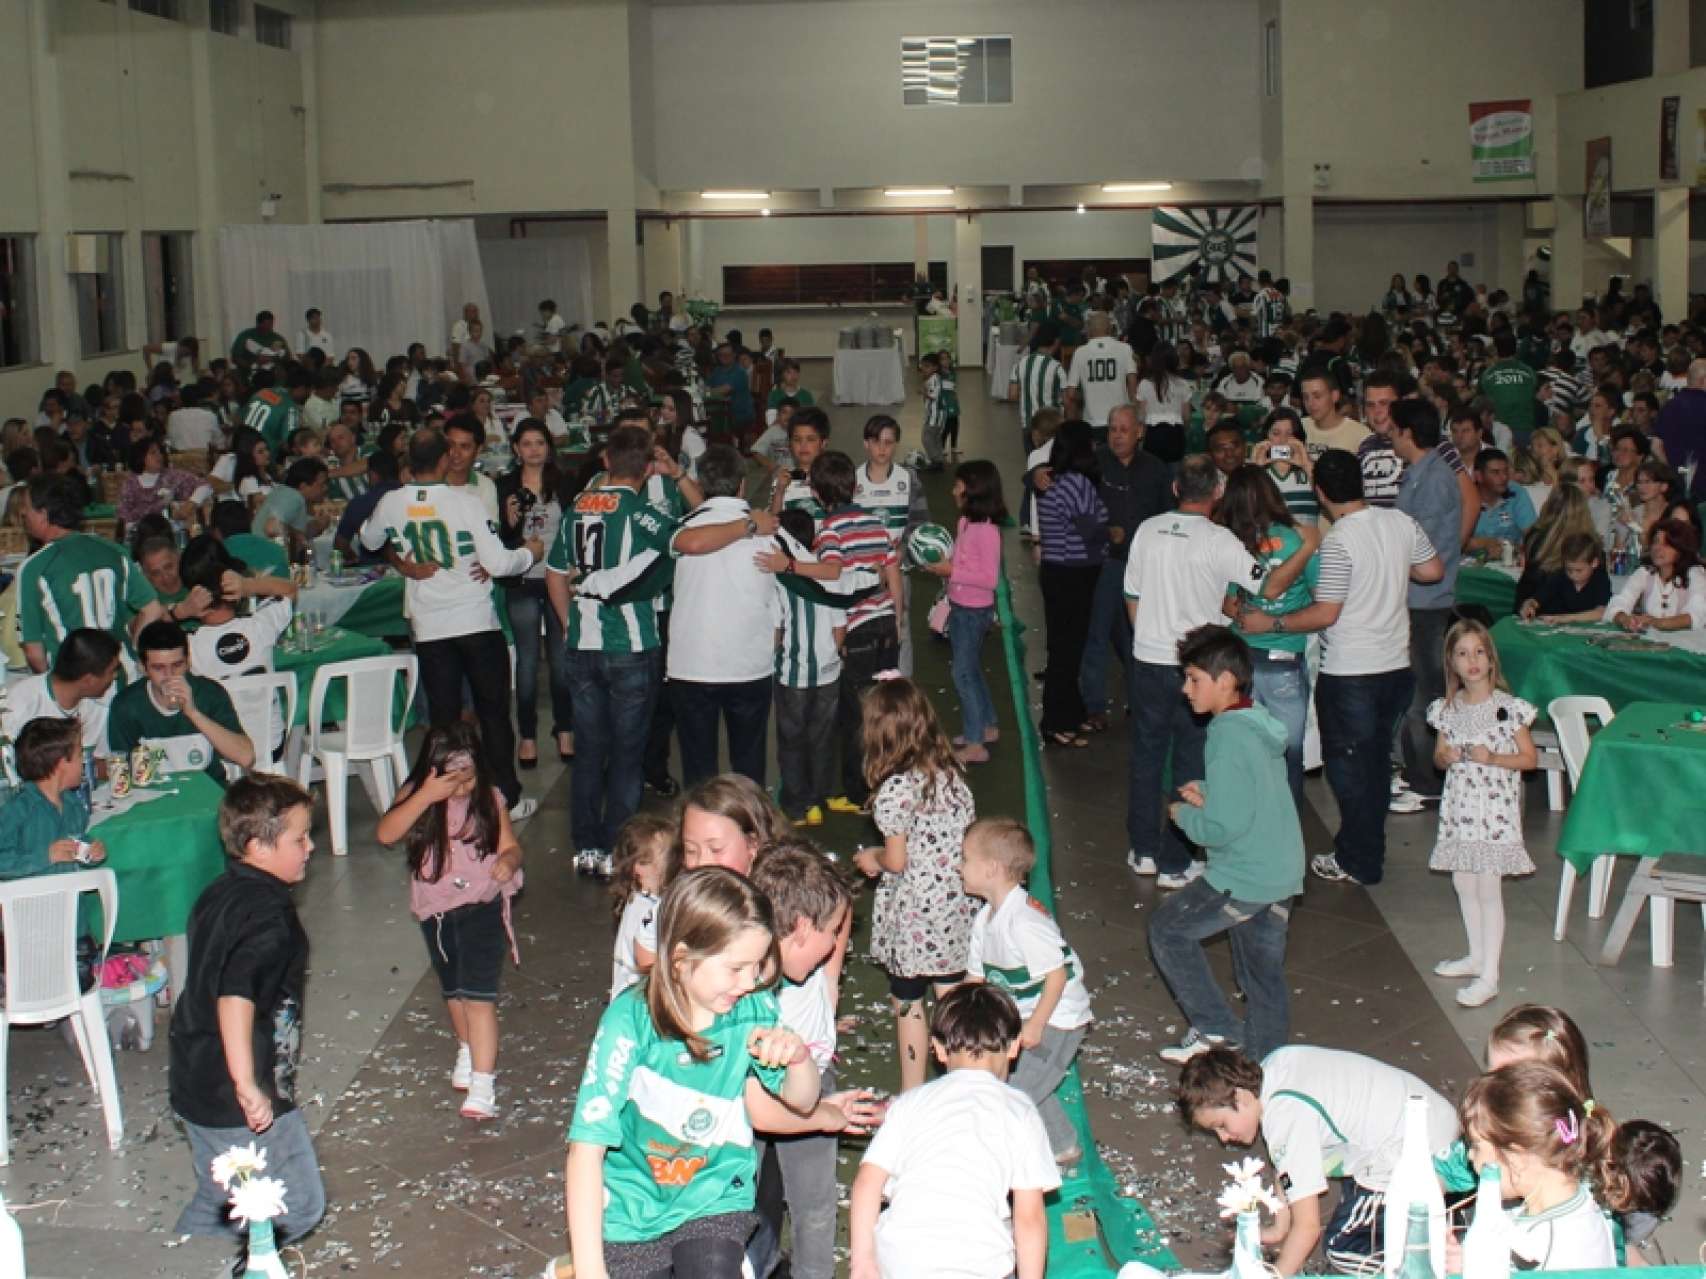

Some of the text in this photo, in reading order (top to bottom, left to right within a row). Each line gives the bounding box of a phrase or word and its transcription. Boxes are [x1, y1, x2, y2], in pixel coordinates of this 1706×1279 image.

[1088, 358, 1116, 381] 100
[403, 520, 454, 570] 10
[71, 567, 116, 629] 10
